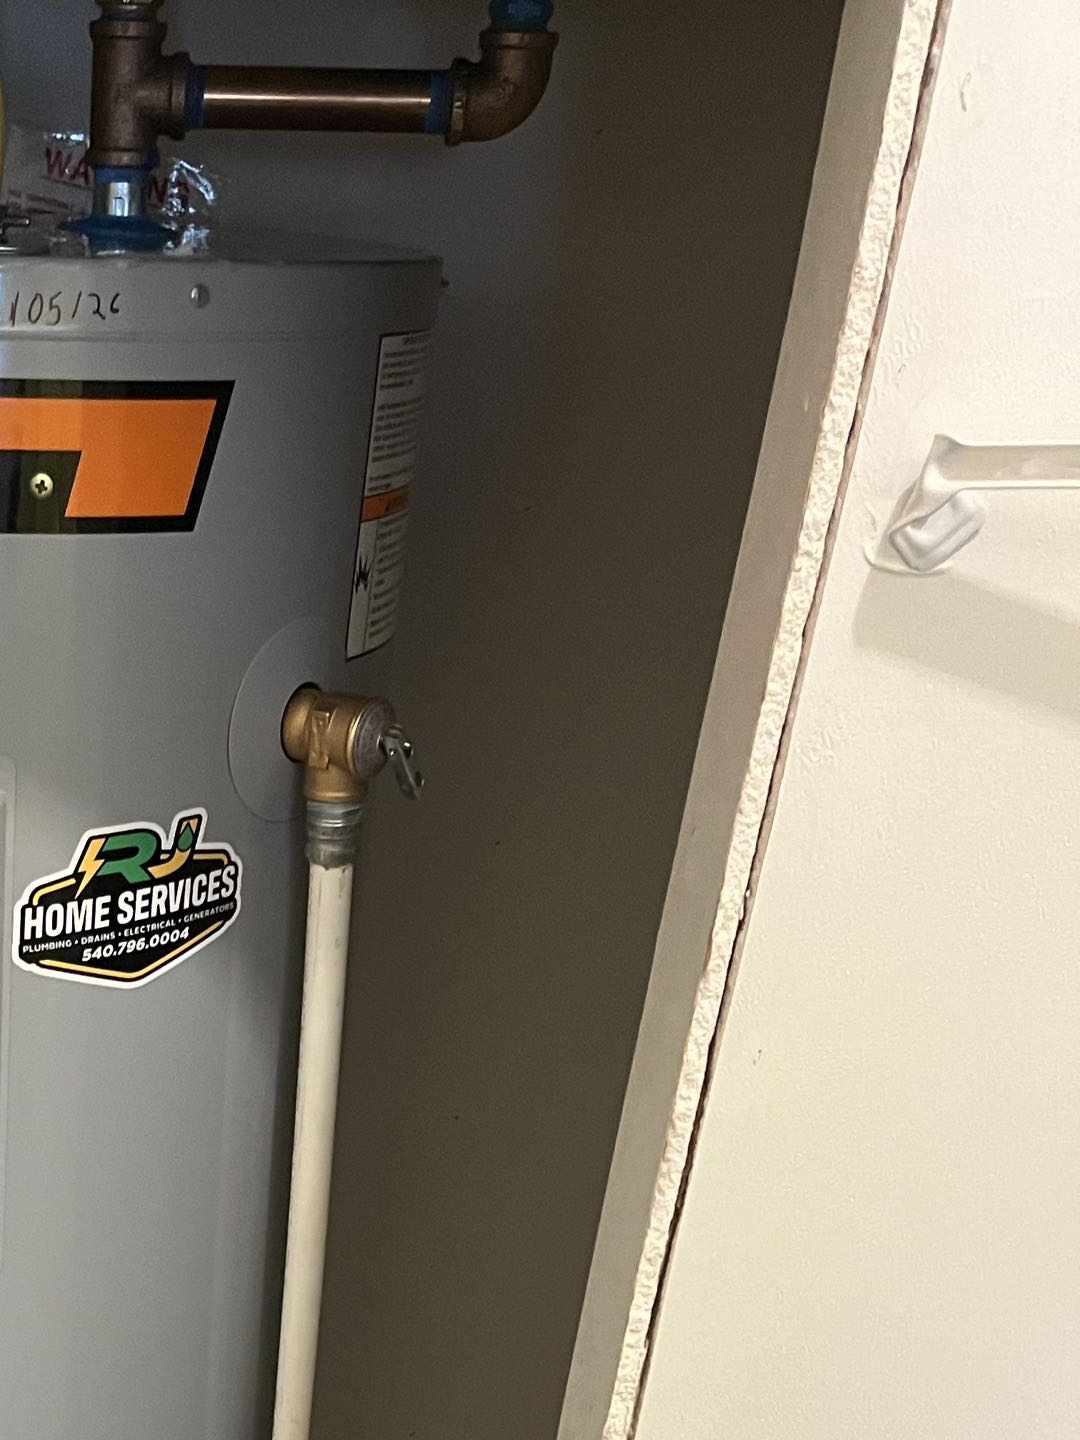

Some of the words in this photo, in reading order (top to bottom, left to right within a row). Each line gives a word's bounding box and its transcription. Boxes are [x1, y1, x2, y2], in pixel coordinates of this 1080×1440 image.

[22, 939, 72, 954] PLUMBING
[80, 931, 116, 946] DRAINS
[123, 919, 177, 937] ELECTRICAL
[183, 901, 234, 923] GENERATORS
[23, 895, 112, 940] HOME
[117, 865, 236, 925] SERVICES
[81, 926, 190, 962] 540.796.0004
